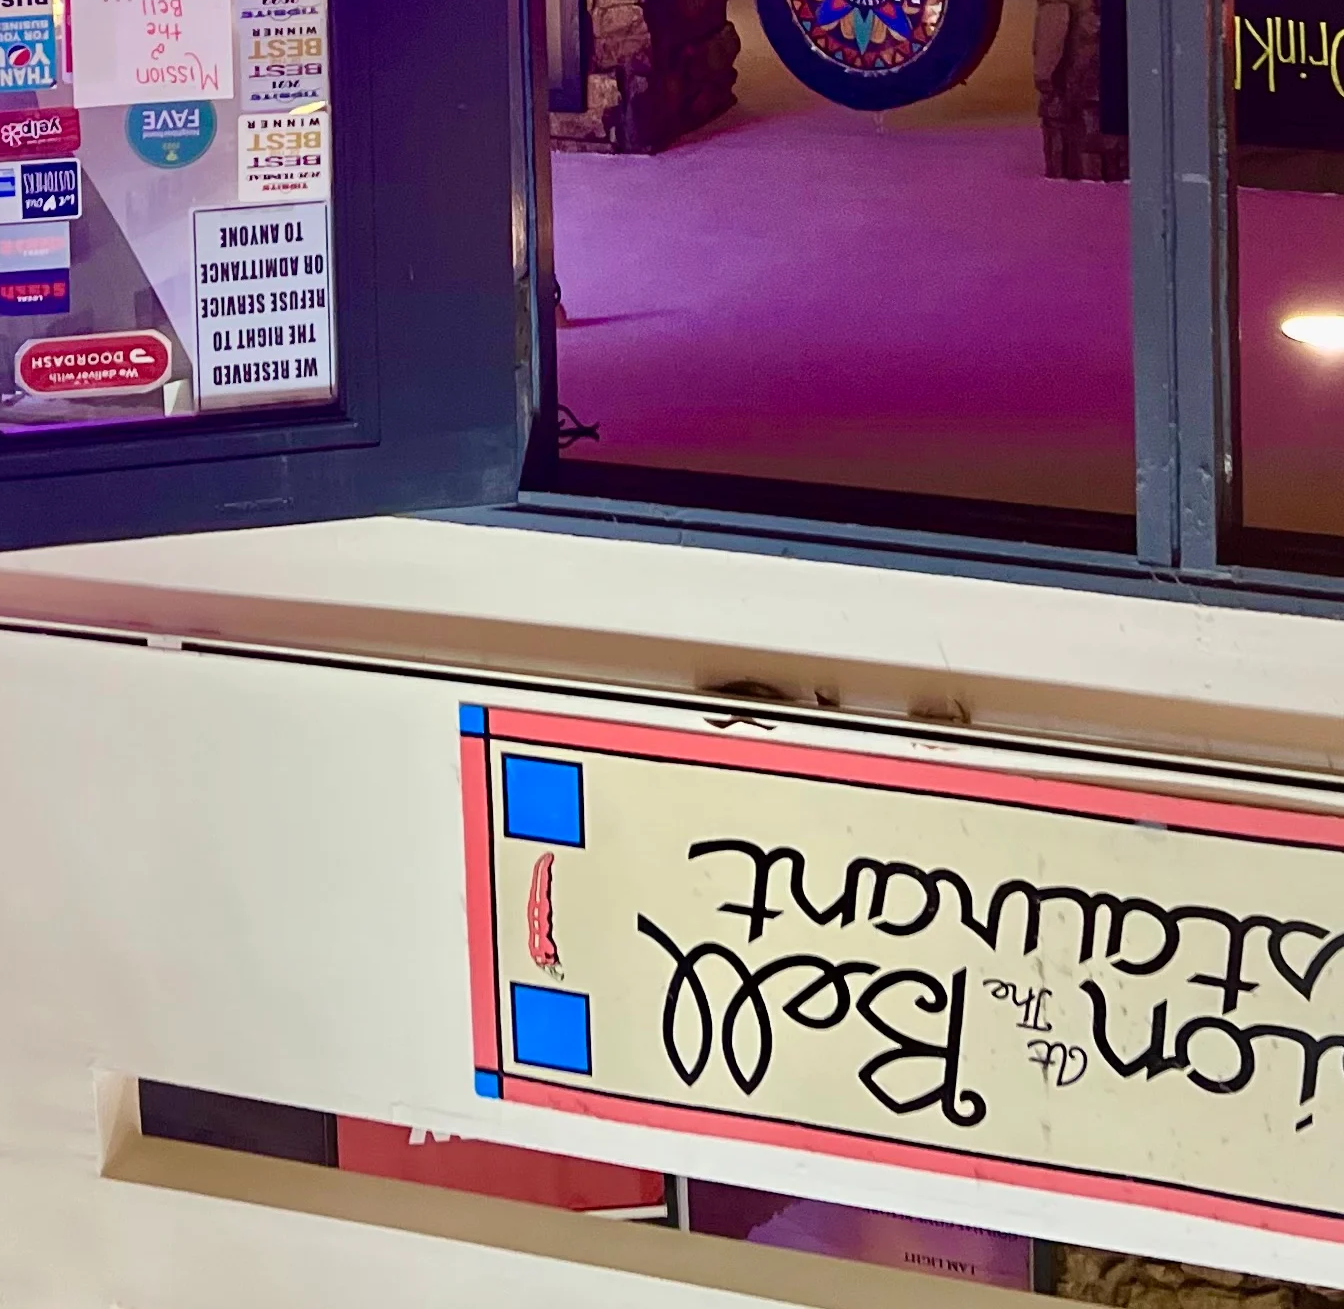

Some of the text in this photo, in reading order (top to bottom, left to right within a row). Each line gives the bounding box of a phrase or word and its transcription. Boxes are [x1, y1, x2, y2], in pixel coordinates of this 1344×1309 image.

[24, 29, 50, 42] FOR
[145, 21, 183, 41] the
[251, 26, 317, 37] WINNER
[247, 37, 322, 59] BEST
[135, 52, 219, 91] Mission
[248, 62, 322, 79] BEST
[21, 116, 60, 139] yelp
[142, 108, 200, 131] FAVE
[247, 117, 320, 129] WINNER
[246, 130, 322, 152] BEST
[247, 154, 322, 169] BEST
[22, 169, 77, 194] CUSTOMERS
[219, 221, 304, 248] TO ANYONE
[200, 254, 324, 284] OR ADMITTANCE
[200, 287, 326, 319] REFUSE SERVICE
[212, 322, 316, 352] THE RIGHT TO
[30, 350, 125, 369] DOORDASH
[48, 368, 138, 383] We deliver with
[212, 357, 317, 386] WE RESERVED
[982, 977, 1053, 1033] The
[637, 914, 987, 1128] Bell
[1028, 1036, 1086, 1088] At
[903, 1251, 942, 1269] LIGHT
